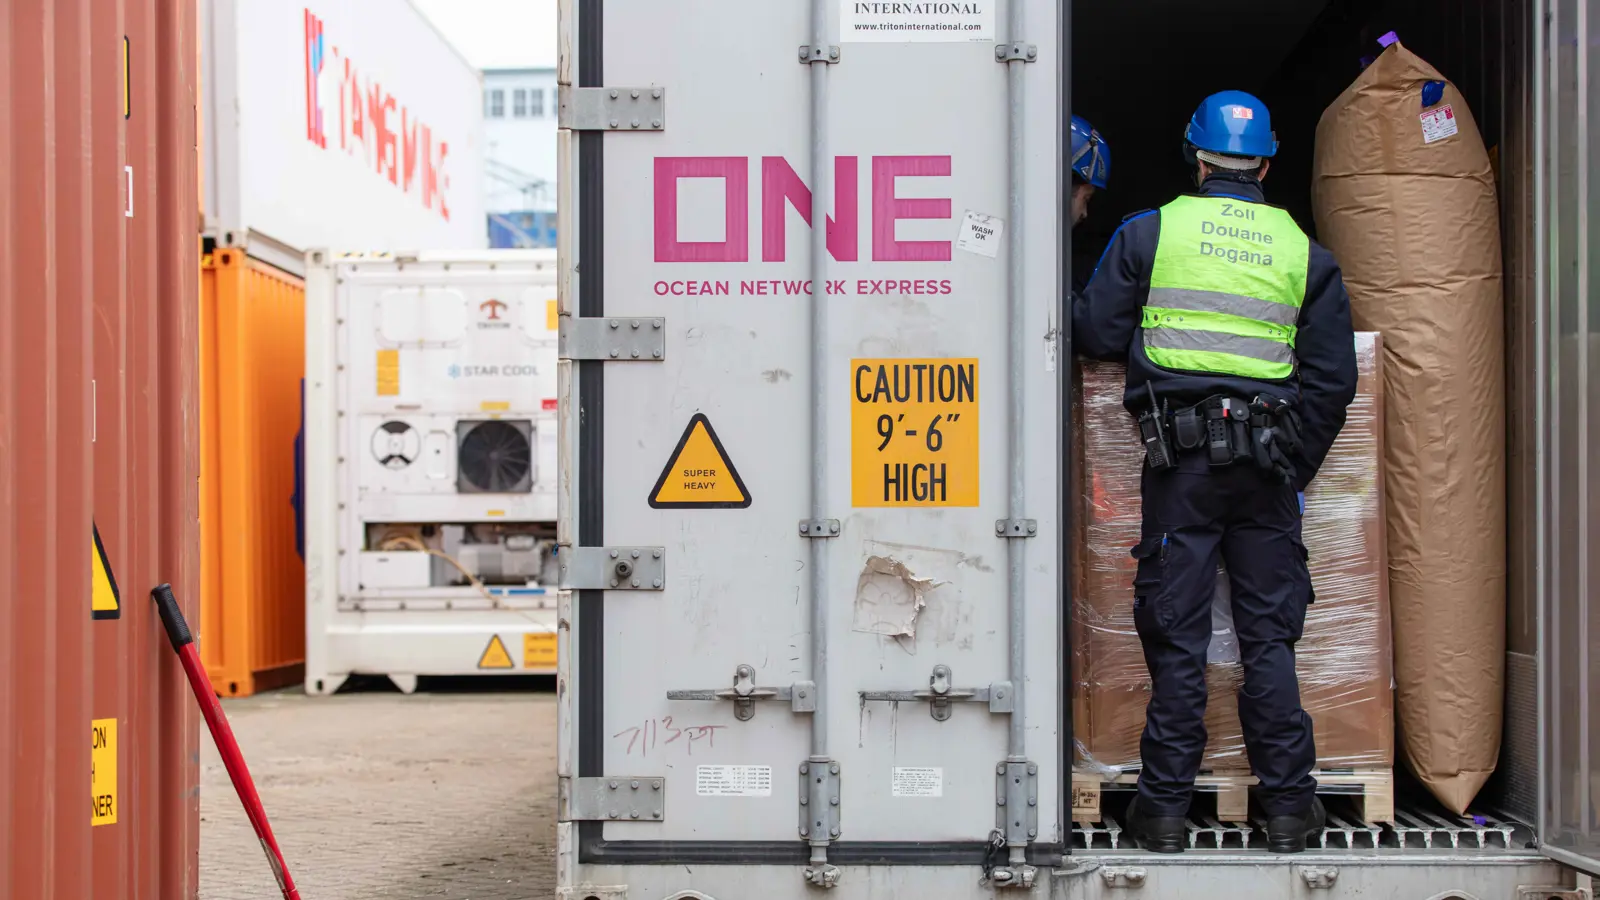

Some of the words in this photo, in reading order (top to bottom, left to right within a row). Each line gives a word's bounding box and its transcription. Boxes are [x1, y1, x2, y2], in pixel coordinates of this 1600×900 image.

[854, 2, 982, 15] INTERNATIONAL
[854, 22, 982, 31] www.tritoninternational.com
[653, 155, 952, 262] ONE
[1221, 203, 1255, 221] Zoll
[971, 224, 994, 236] WASH
[975, 232, 986, 241] OK
[1201, 221, 1273, 244] Douane
[1200, 241, 1273, 266] Dogana
[653, 280, 730, 296] OCEAN
[856, 279, 952, 295] EXPRESS
[464, 366, 499, 377] STAR
[502, 365, 540, 376] COOL
[855, 364, 975, 403] CAUTION
[683, 469, 716, 477] SUPER
[684, 482, 716, 490] HEAVY
[884, 463, 947, 502] HIGH
